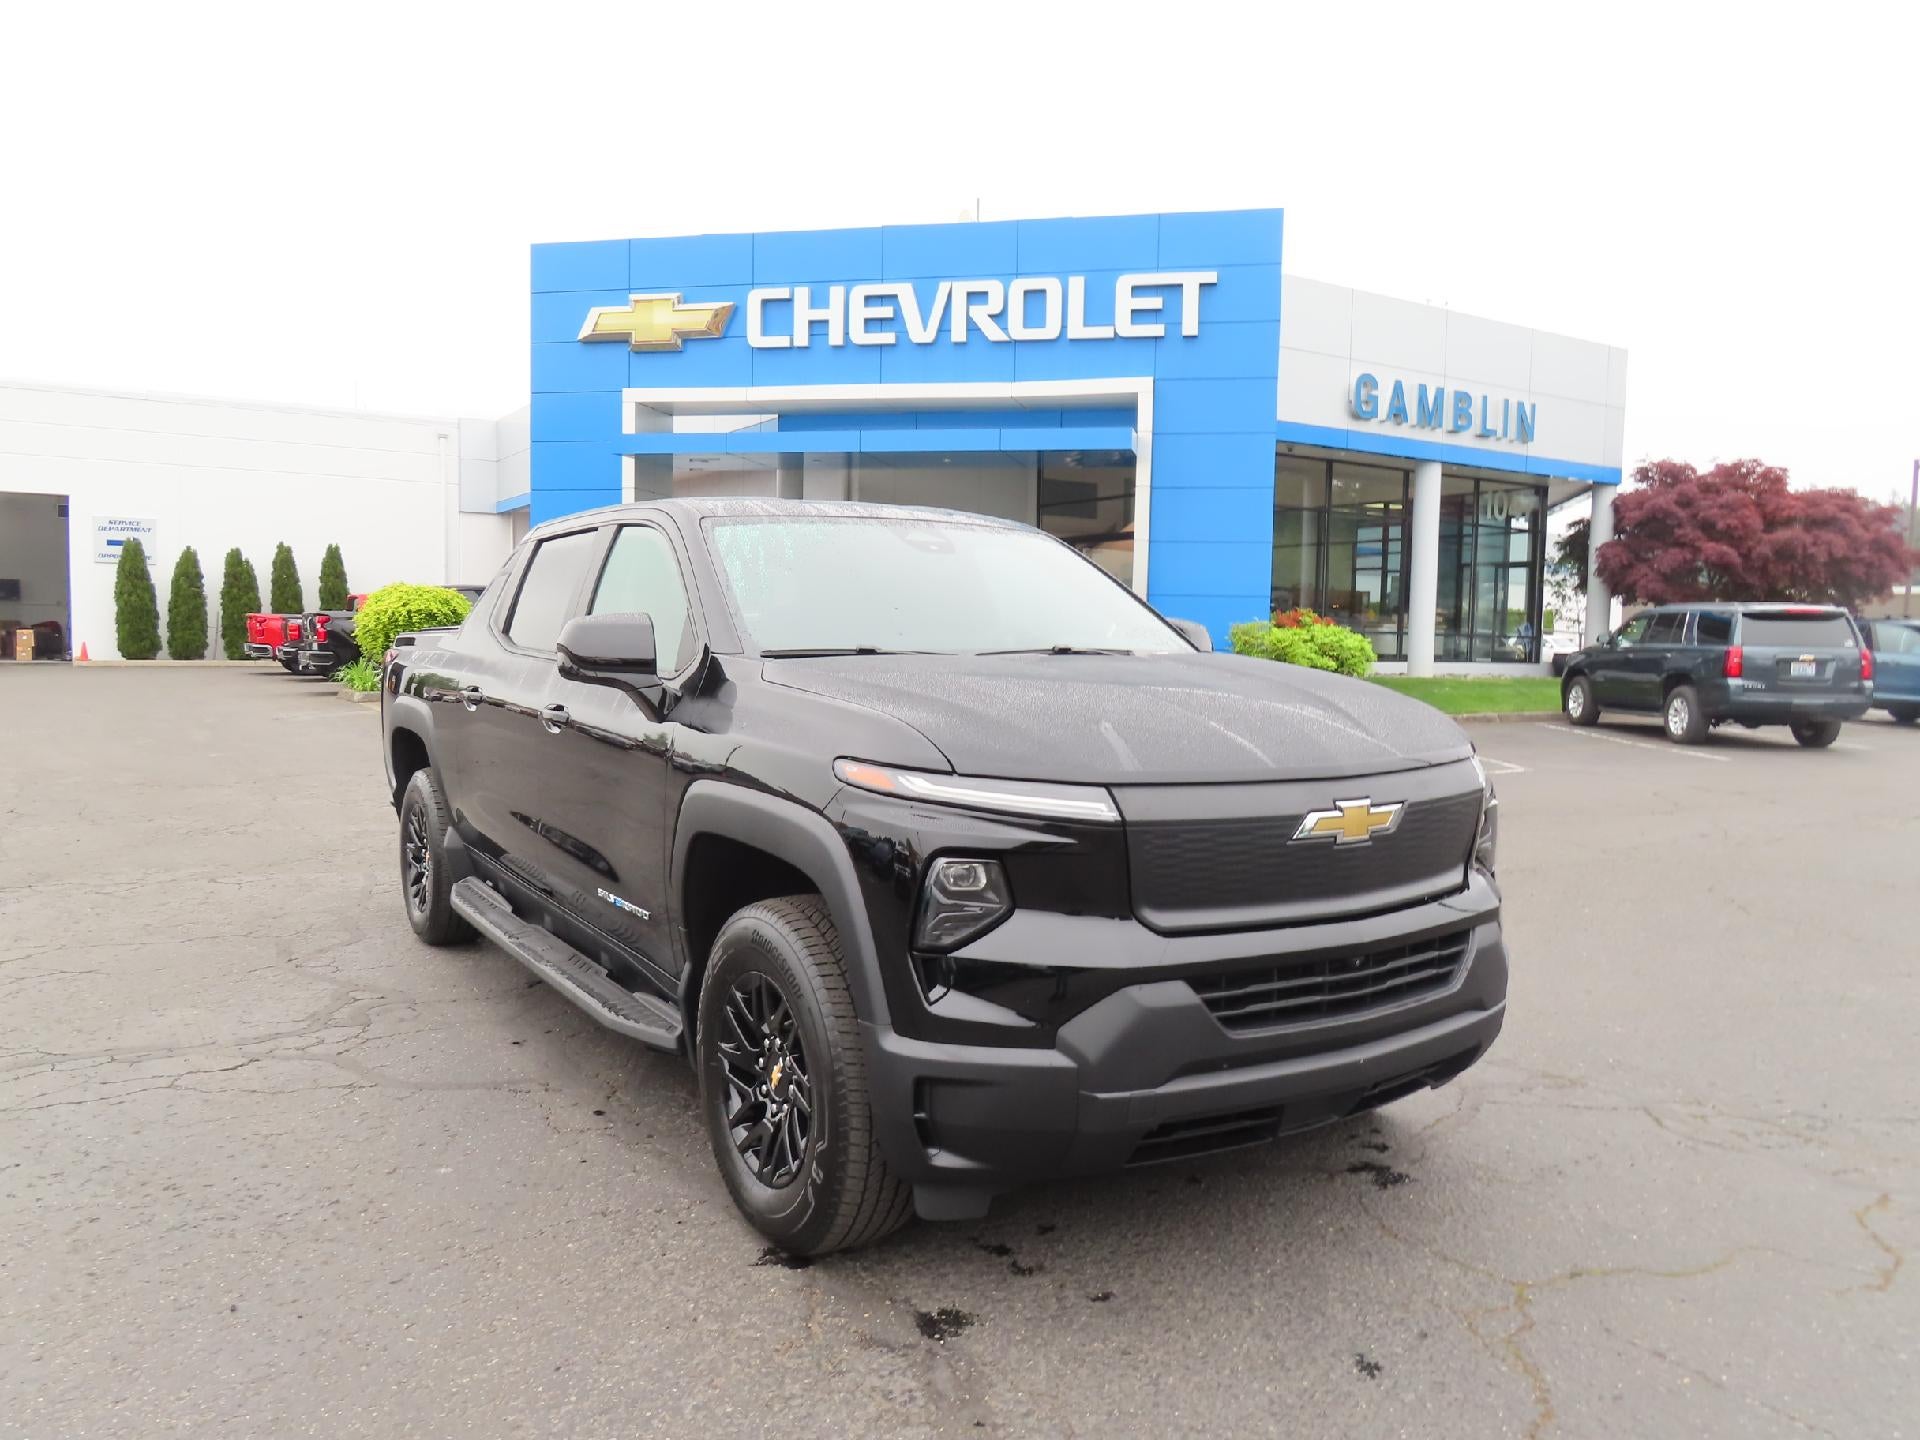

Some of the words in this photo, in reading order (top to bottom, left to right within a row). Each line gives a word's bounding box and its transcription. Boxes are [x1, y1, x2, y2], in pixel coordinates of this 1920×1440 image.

[746, 271, 1217, 348] CHEVROLET
[1354, 373, 1536, 443] GAMBLIN
[108, 519, 141, 527] SERVICE
